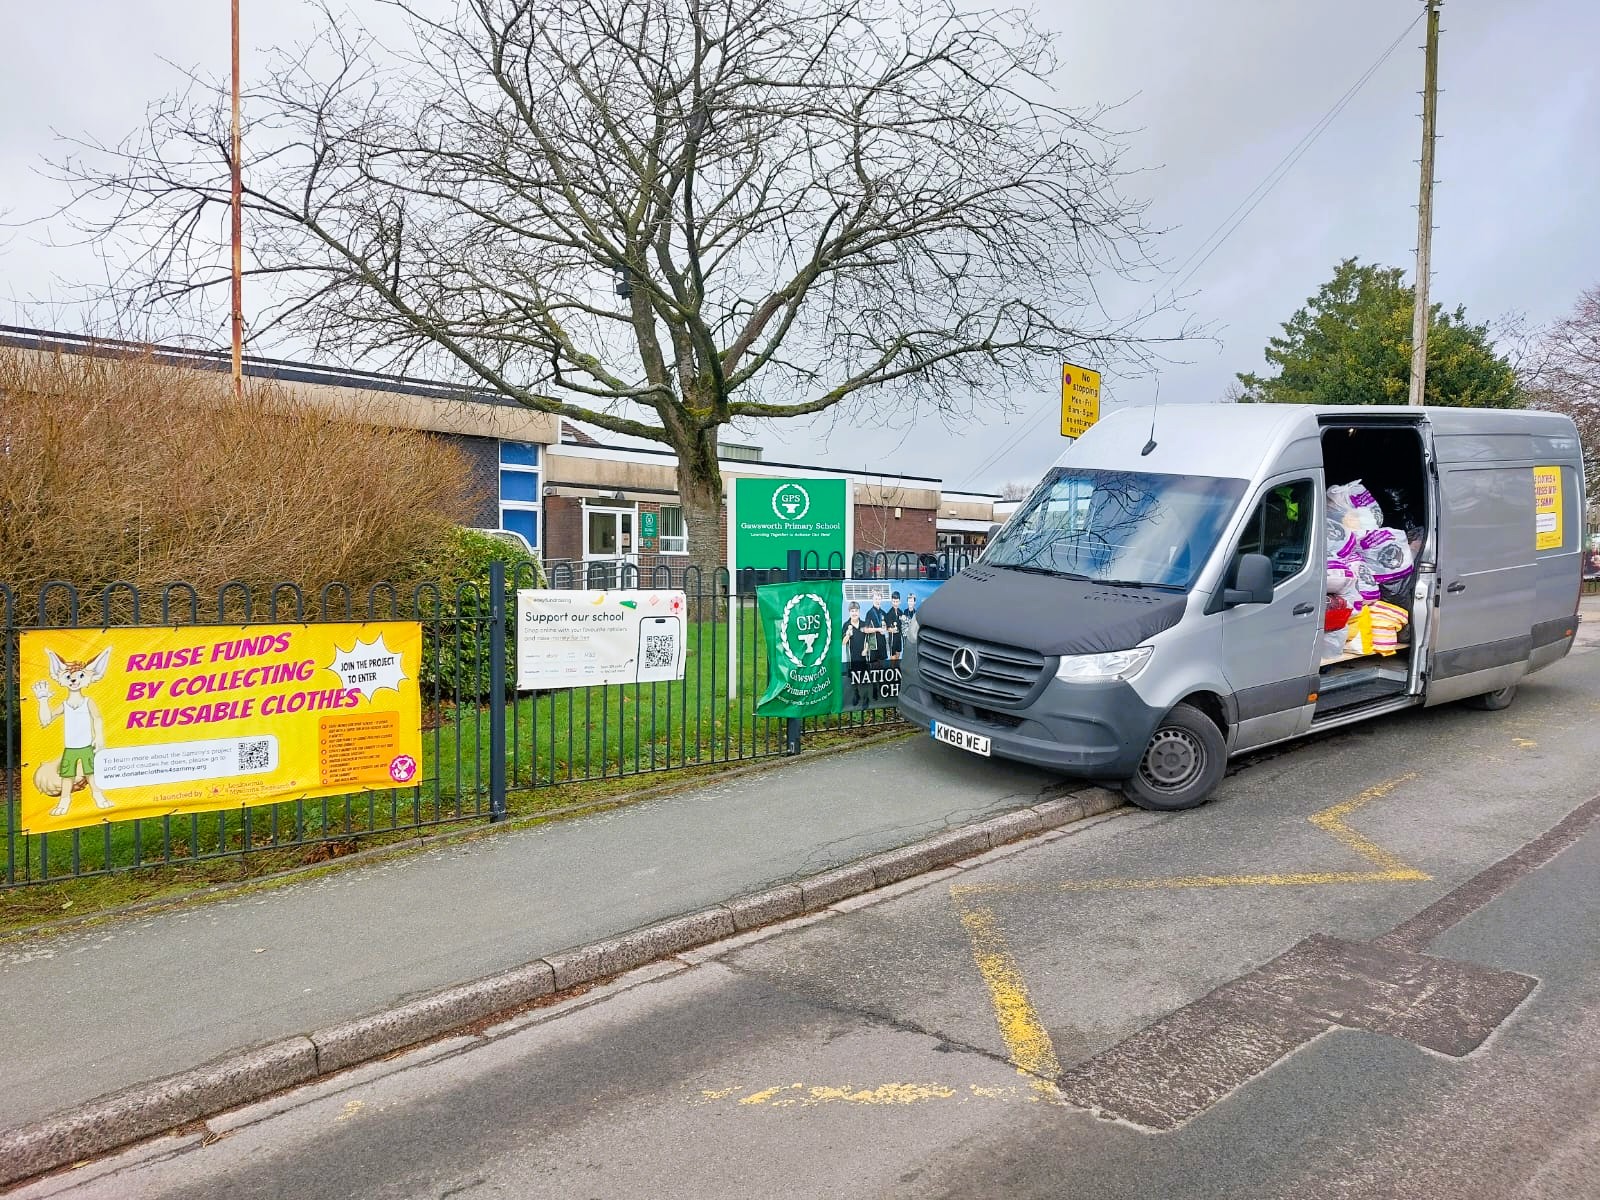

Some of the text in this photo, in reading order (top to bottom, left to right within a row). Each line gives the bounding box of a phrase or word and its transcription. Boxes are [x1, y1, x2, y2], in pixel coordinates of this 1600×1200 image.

[1081, 372, 1091, 383] No
[1073, 383, 1098, 398] stopping
[781, 494, 801, 503] GPS
[740, 522, 841, 531] Gawsworth Primary School
[525, 611, 624, 624] Support our school
[796, 614, 820, 631] GPS
[126, 632, 292, 673] RAISE FUNDS
[340, 656, 395, 672] JOIN THE PROJECT
[126, 660, 315, 701] BY COLLECTING
[347, 672, 377, 684] TO ENTER
[811, 676, 831, 695] School
[126, 687, 361, 729] REUSABLE CLOTHES
[937, 724, 989, 753] KW68 WEJ
[150, 752, 169, 760] about
[160, 790, 192, 801] launched
[193, 789, 203, 798] by
